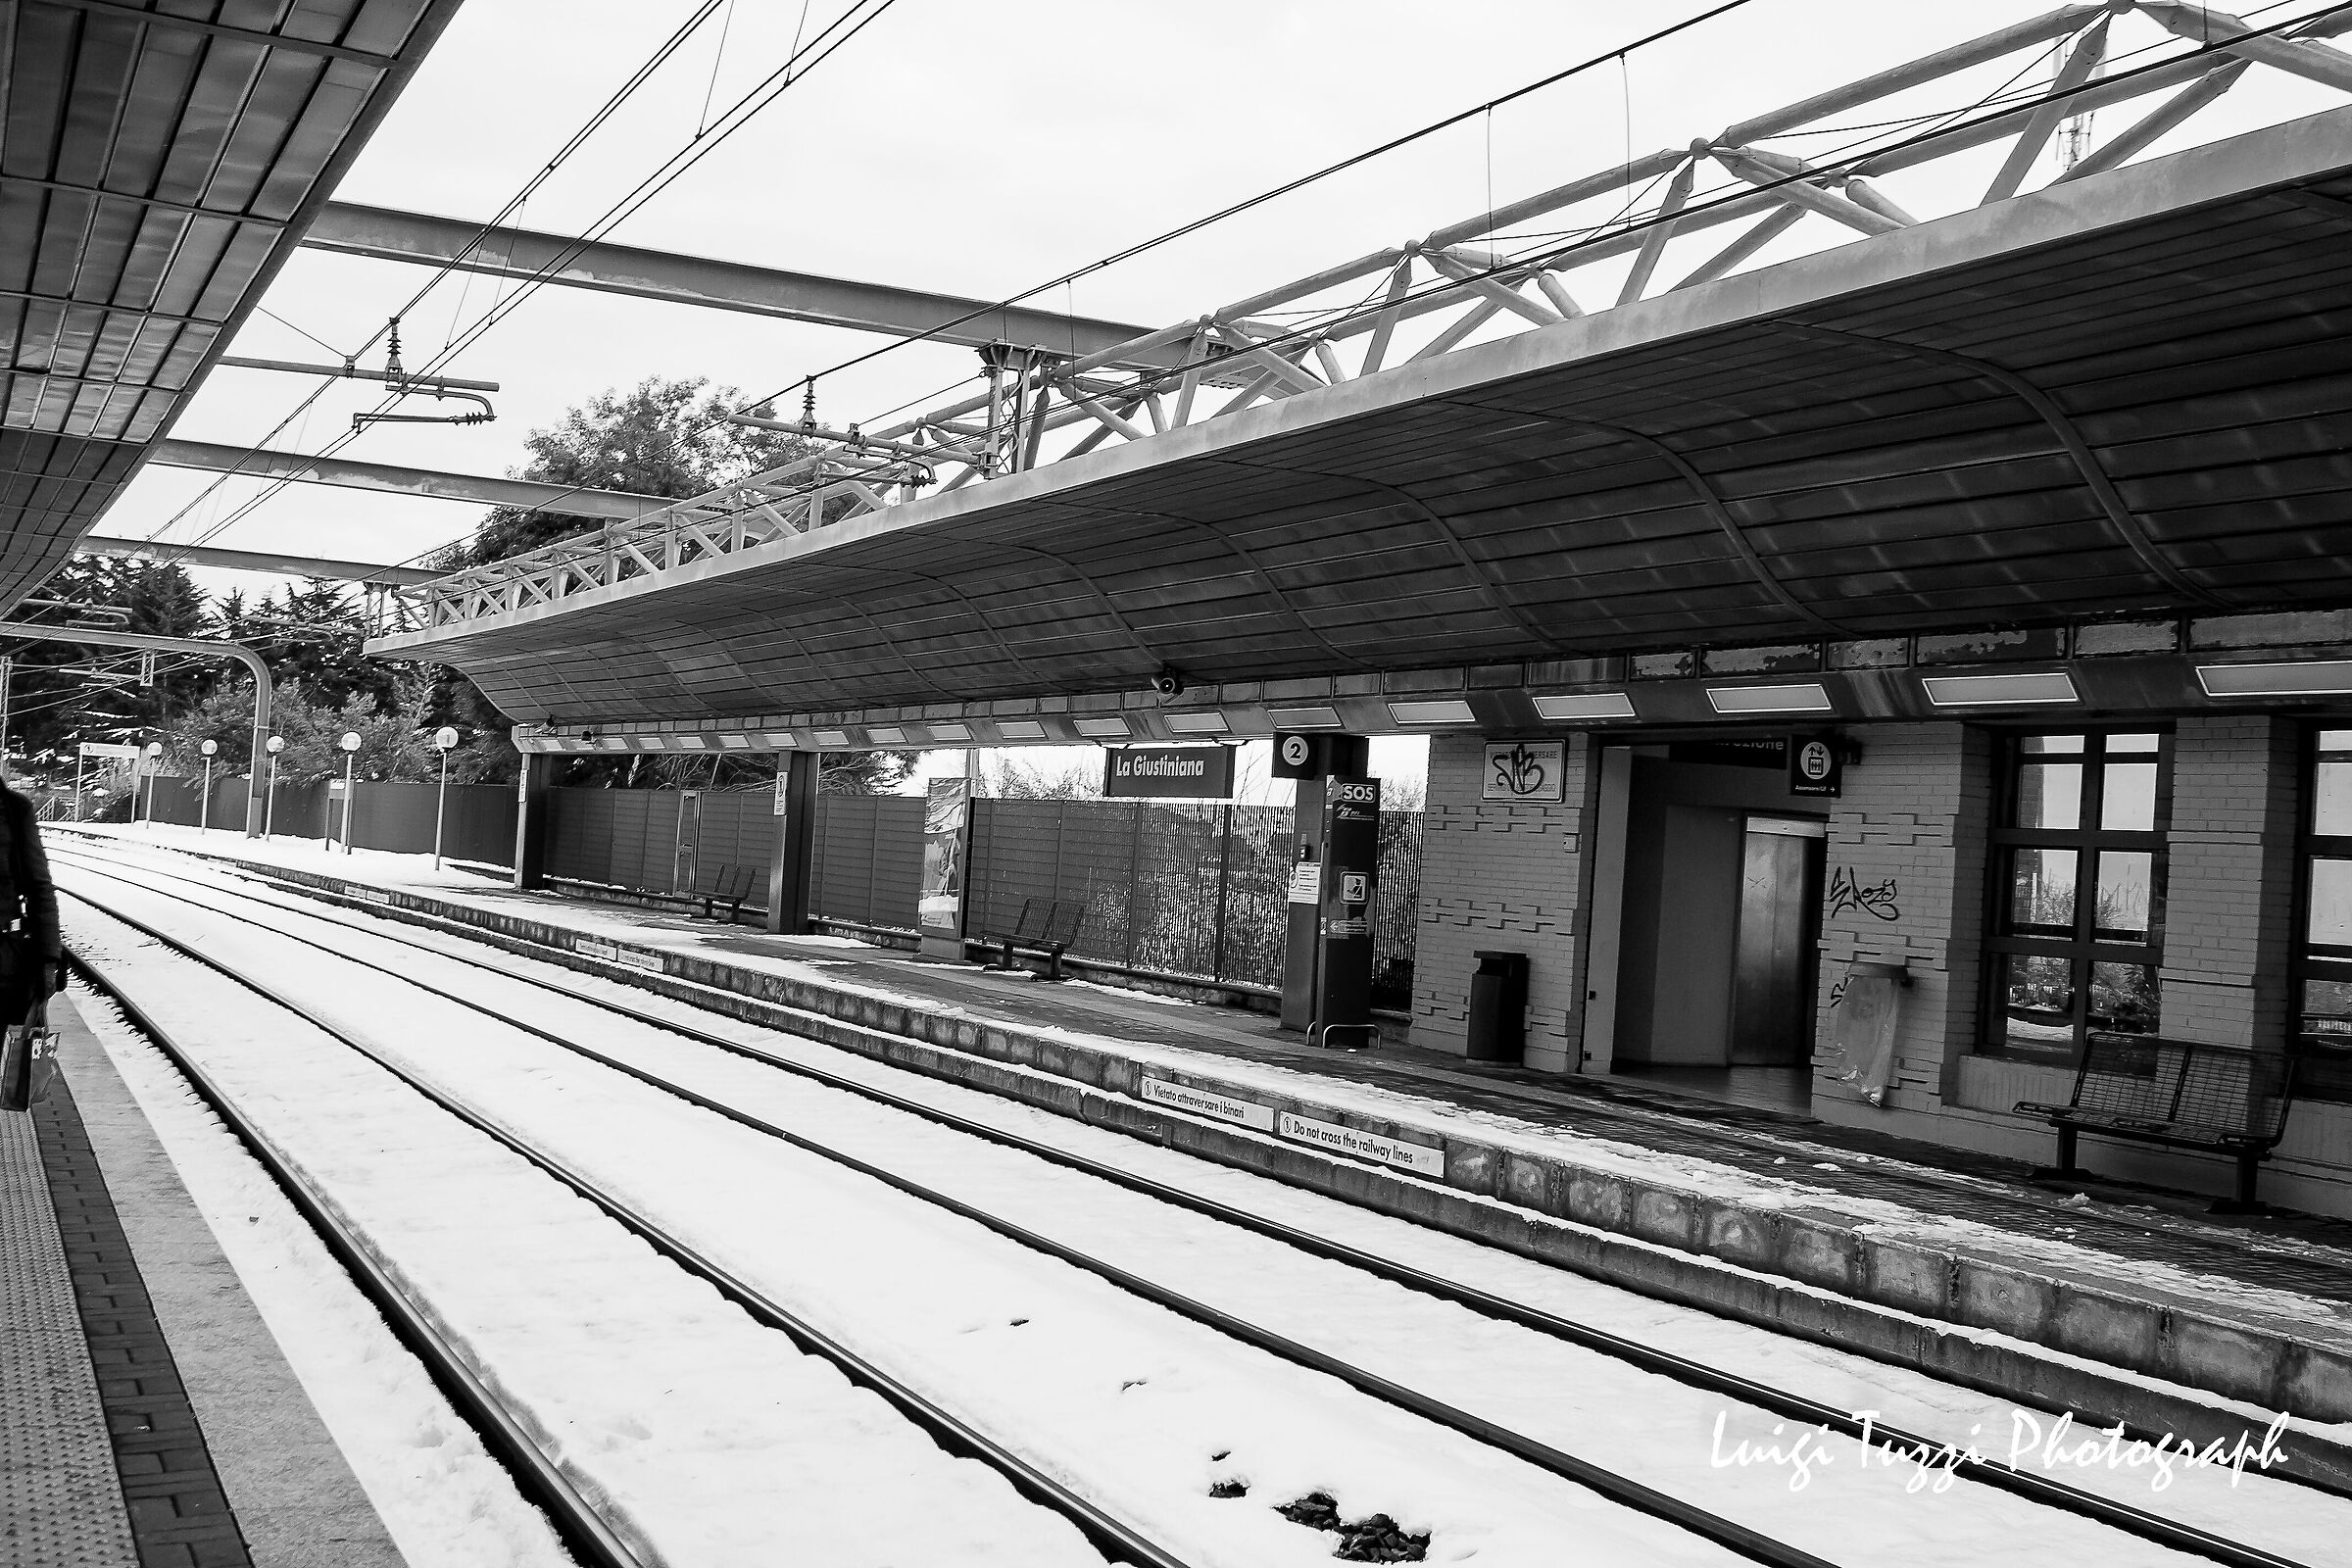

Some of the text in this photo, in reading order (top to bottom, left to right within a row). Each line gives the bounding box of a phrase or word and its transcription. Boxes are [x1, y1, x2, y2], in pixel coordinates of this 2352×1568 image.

[1289, 742, 1301, 760] 2
[1116, 754, 1204, 777] La Giustiniana
[1343, 785, 1374, 801] SOS
[1153, 1084, 1177, 1102] Vietato
[1178, 1093, 1219, 1112] attraversare
[1223, 1102, 1245, 1118] binari
[1294, 1120, 1413, 1163] Do not cross the railway lines
